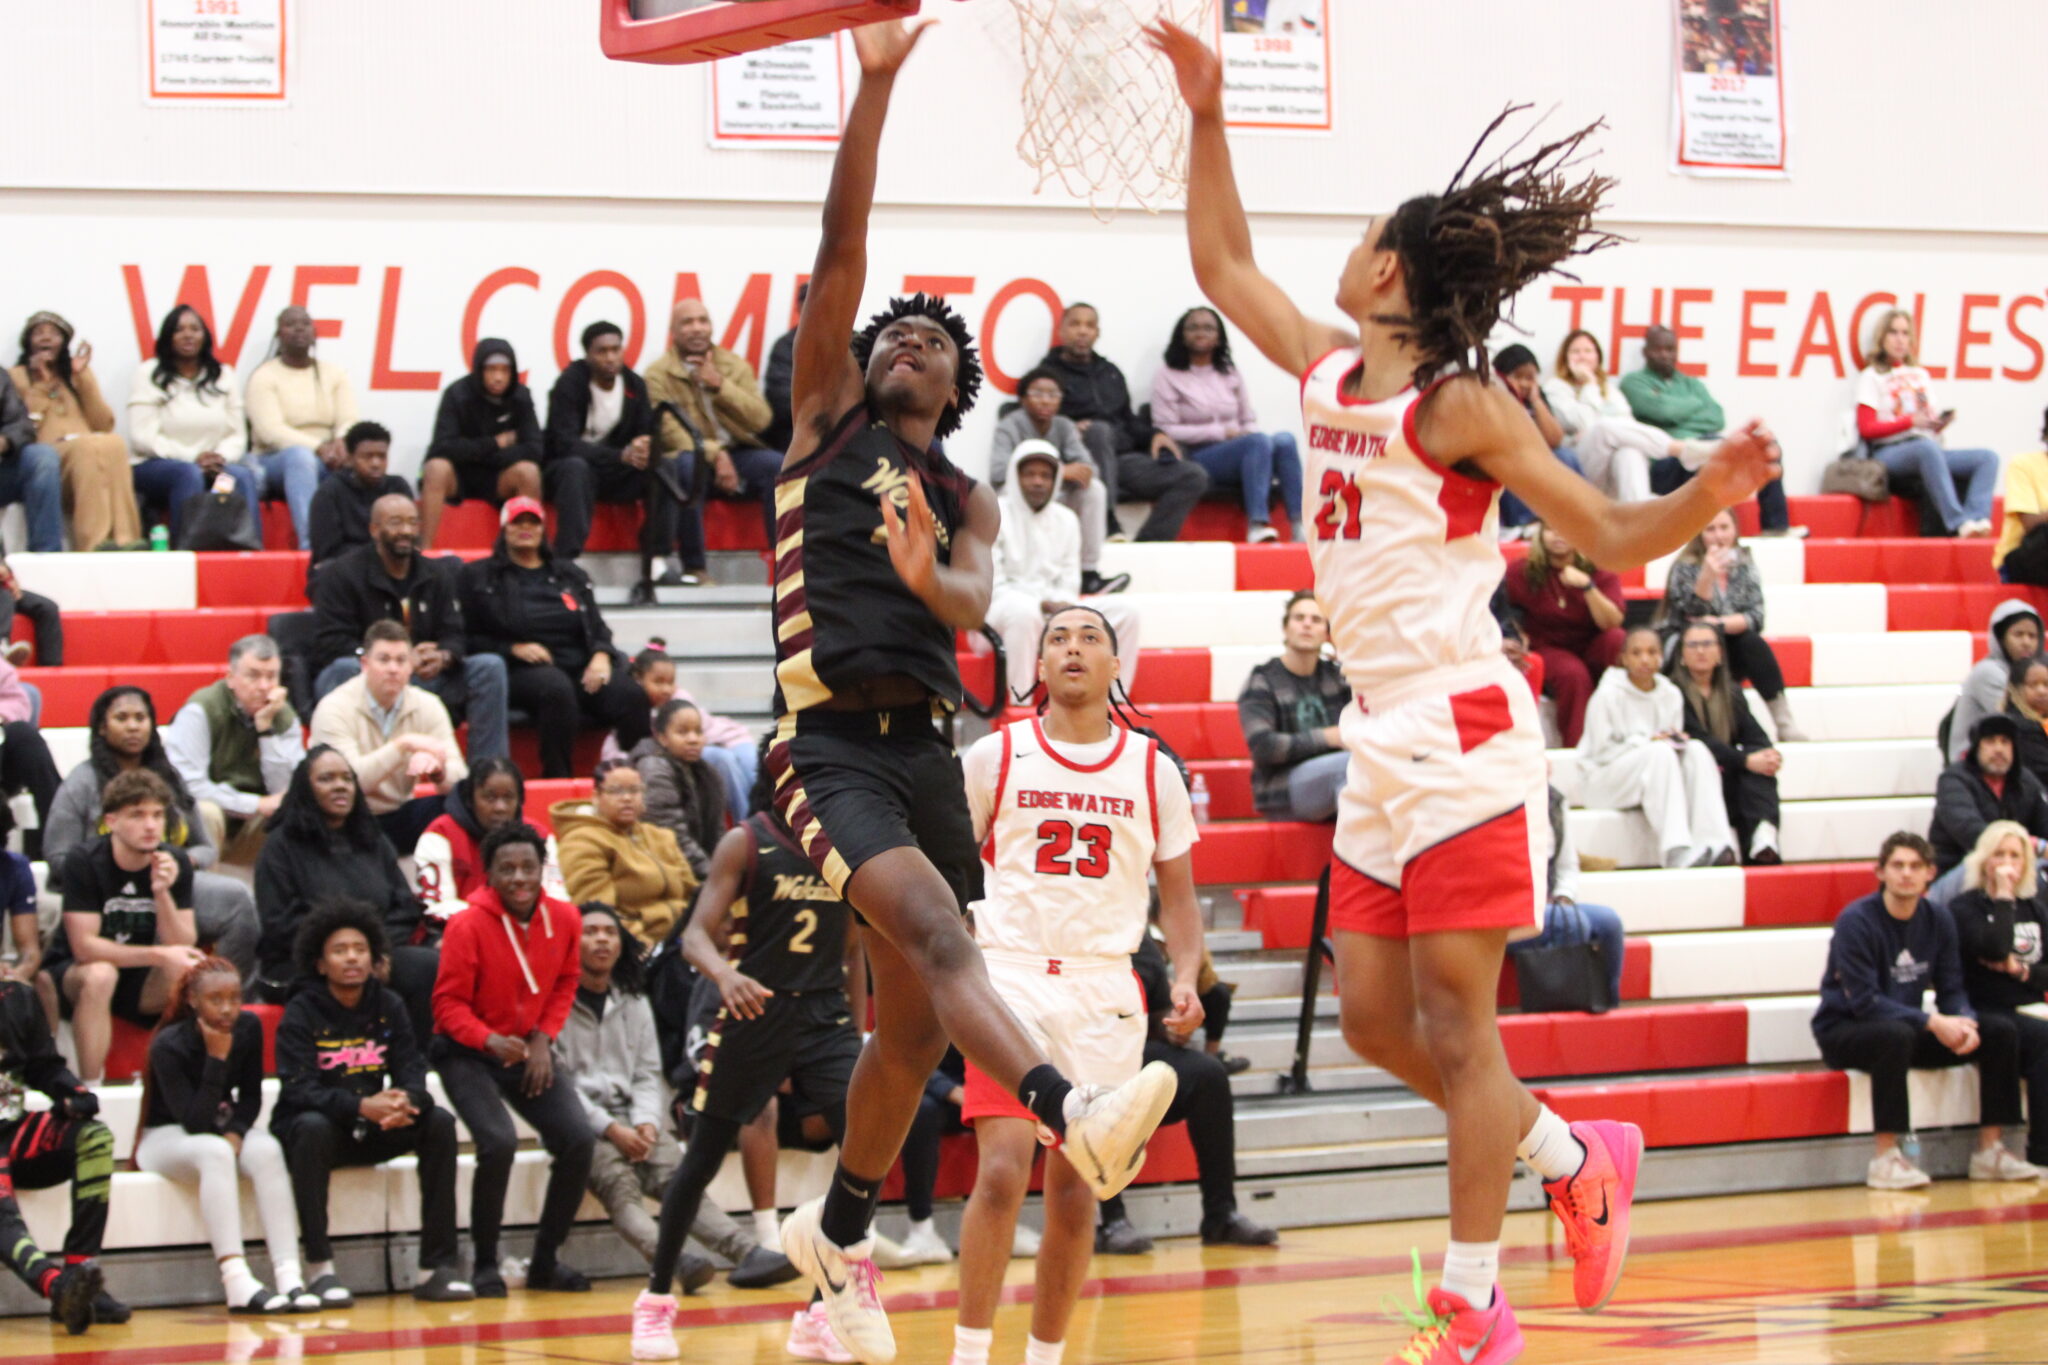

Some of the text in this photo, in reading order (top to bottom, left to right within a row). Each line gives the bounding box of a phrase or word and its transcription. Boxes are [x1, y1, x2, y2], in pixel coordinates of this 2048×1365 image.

[122, 264, 814, 391] WELCOM
[1550, 286, 1713, 377] THE
[1737, 288, 2048, 382] EAGLES
[1017, 790, 1135, 818] EDGEWATER
[1035, 819, 1112, 879] 23
[788, 908, 818, 954] 2
